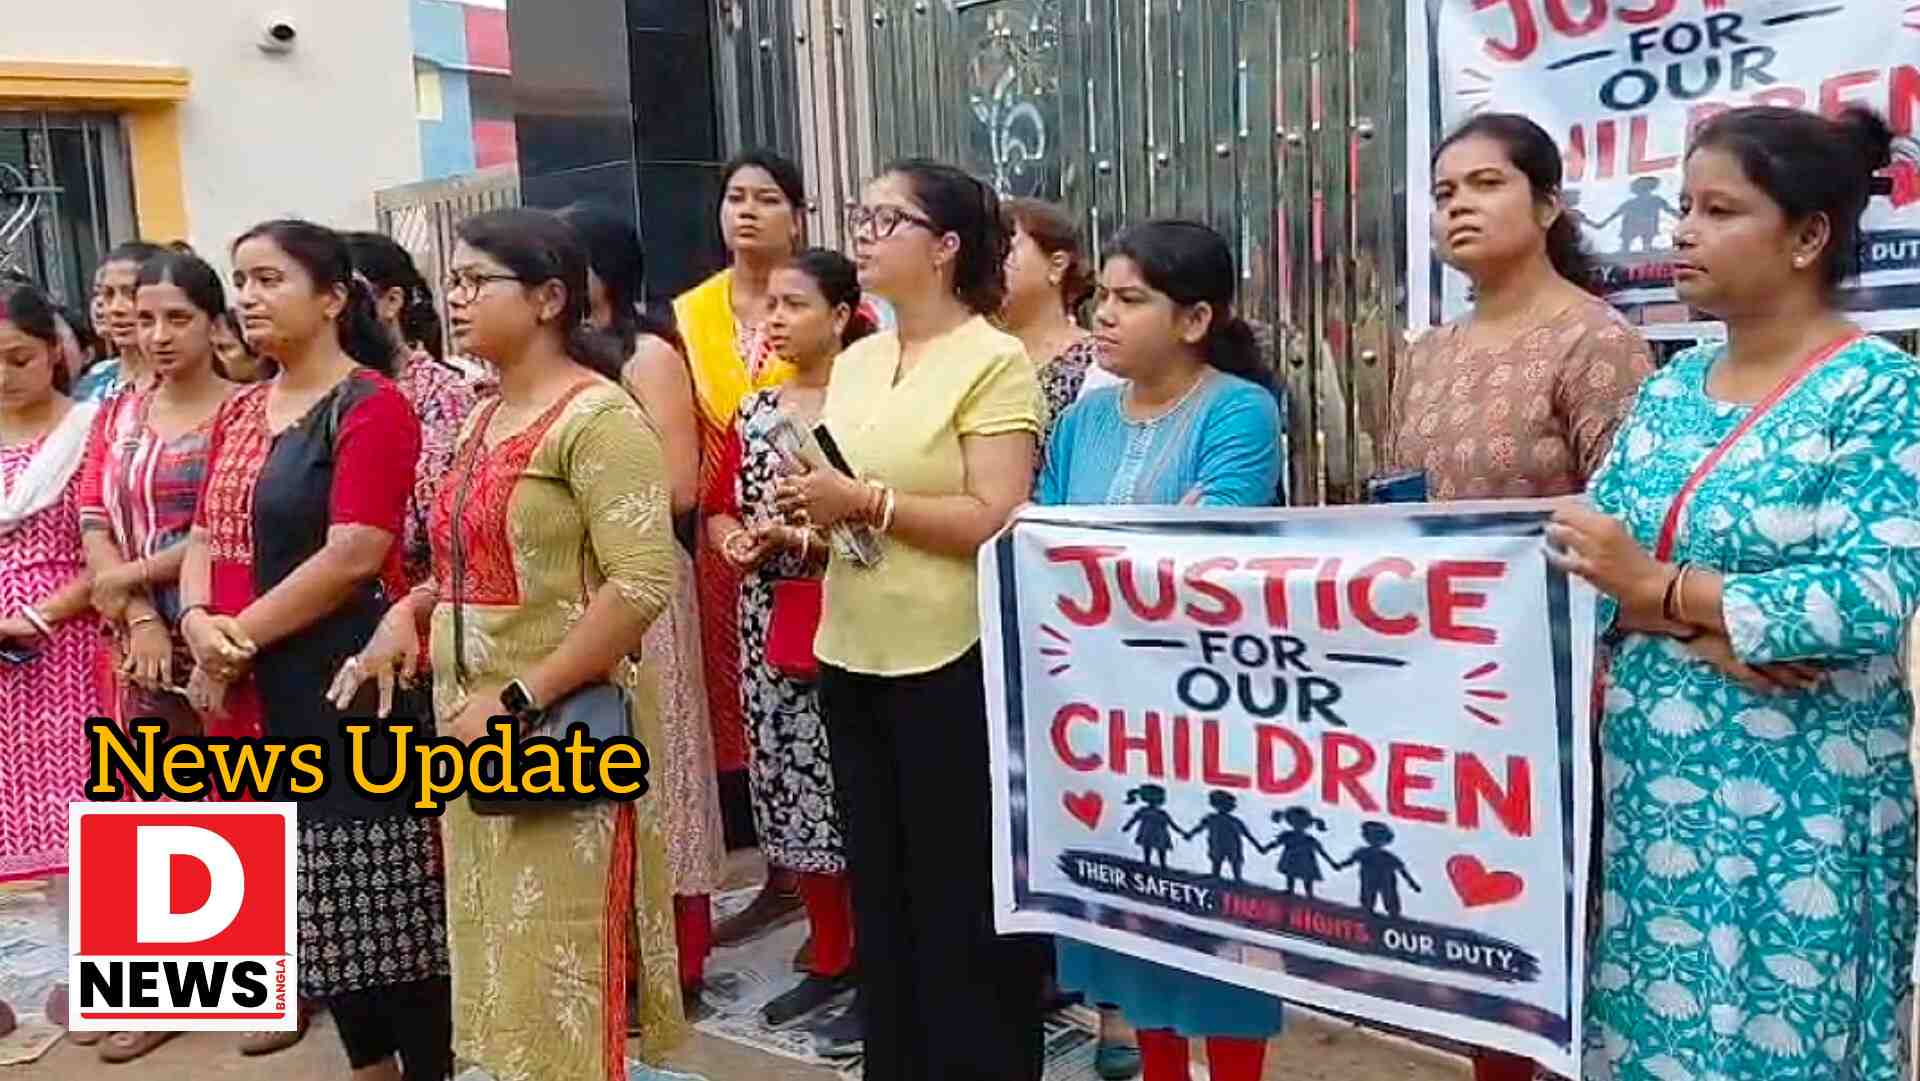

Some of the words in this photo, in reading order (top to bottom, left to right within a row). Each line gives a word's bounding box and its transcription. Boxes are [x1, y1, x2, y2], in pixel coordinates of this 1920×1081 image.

[1629, 12, 1748, 62] FOR
[1598, 45, 1778, 111] OUR
[1044, 545, 1507, 645] JUSTICE
[1198, 630, 1312, 672] FOR
[1177, 666, 1347, 728] OUR
[1050, 702, 1532, 838] CHILDREN
[1075, 859, 1128, 890] THEIR
[1133, 873, 1214, 910] SAFETY.
[1382, 927, 1437, 957] OUR
[1445, 940, 1520, 973] DUTY.
